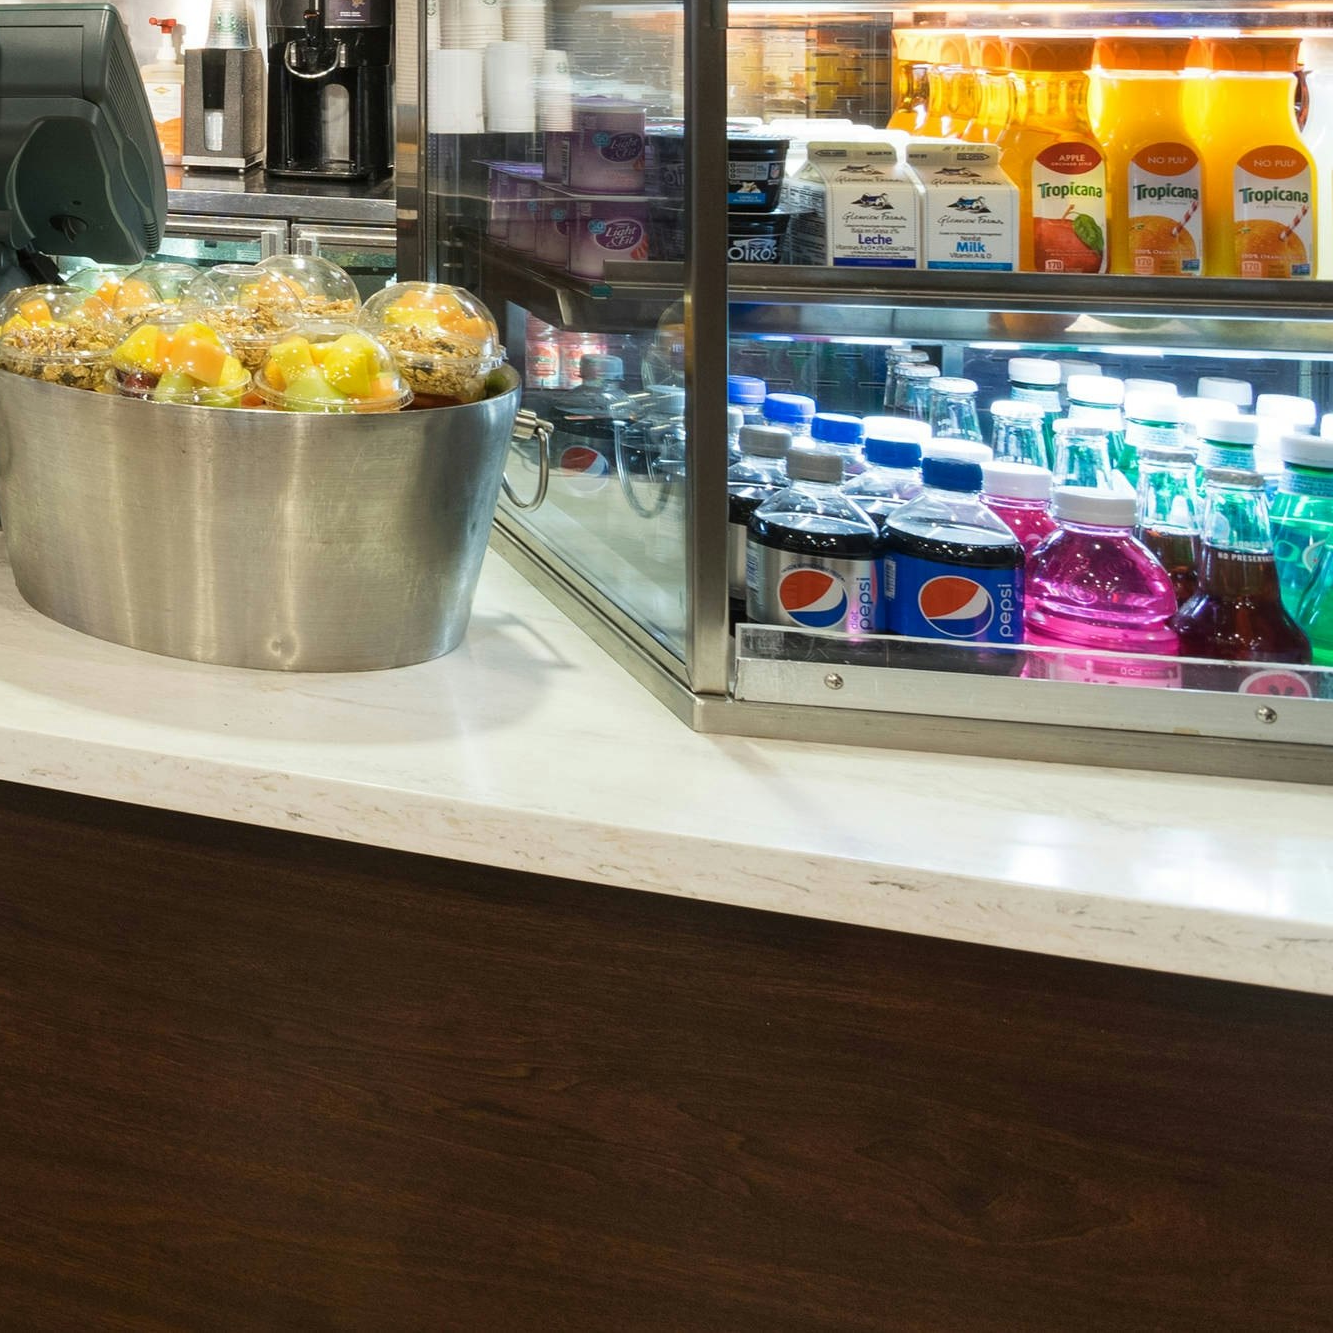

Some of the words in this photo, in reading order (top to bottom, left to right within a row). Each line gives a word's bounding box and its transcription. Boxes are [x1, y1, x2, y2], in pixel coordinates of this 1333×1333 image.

[1037, 182, 1102, 199] Tropicana
[1134, 183, 1198, 200] Tropicana
[1239, 187, 1308, 204] Tropicana
[605, 223, 637, 237] Light
[858, 234, 892, 244] Leche
[957, 242, 986, 252] Milk
[728, 247, 777, 261] OIKOS
[856, 577, 873, 630] pepsi
[998, 584, 1014, 638] pepsi
